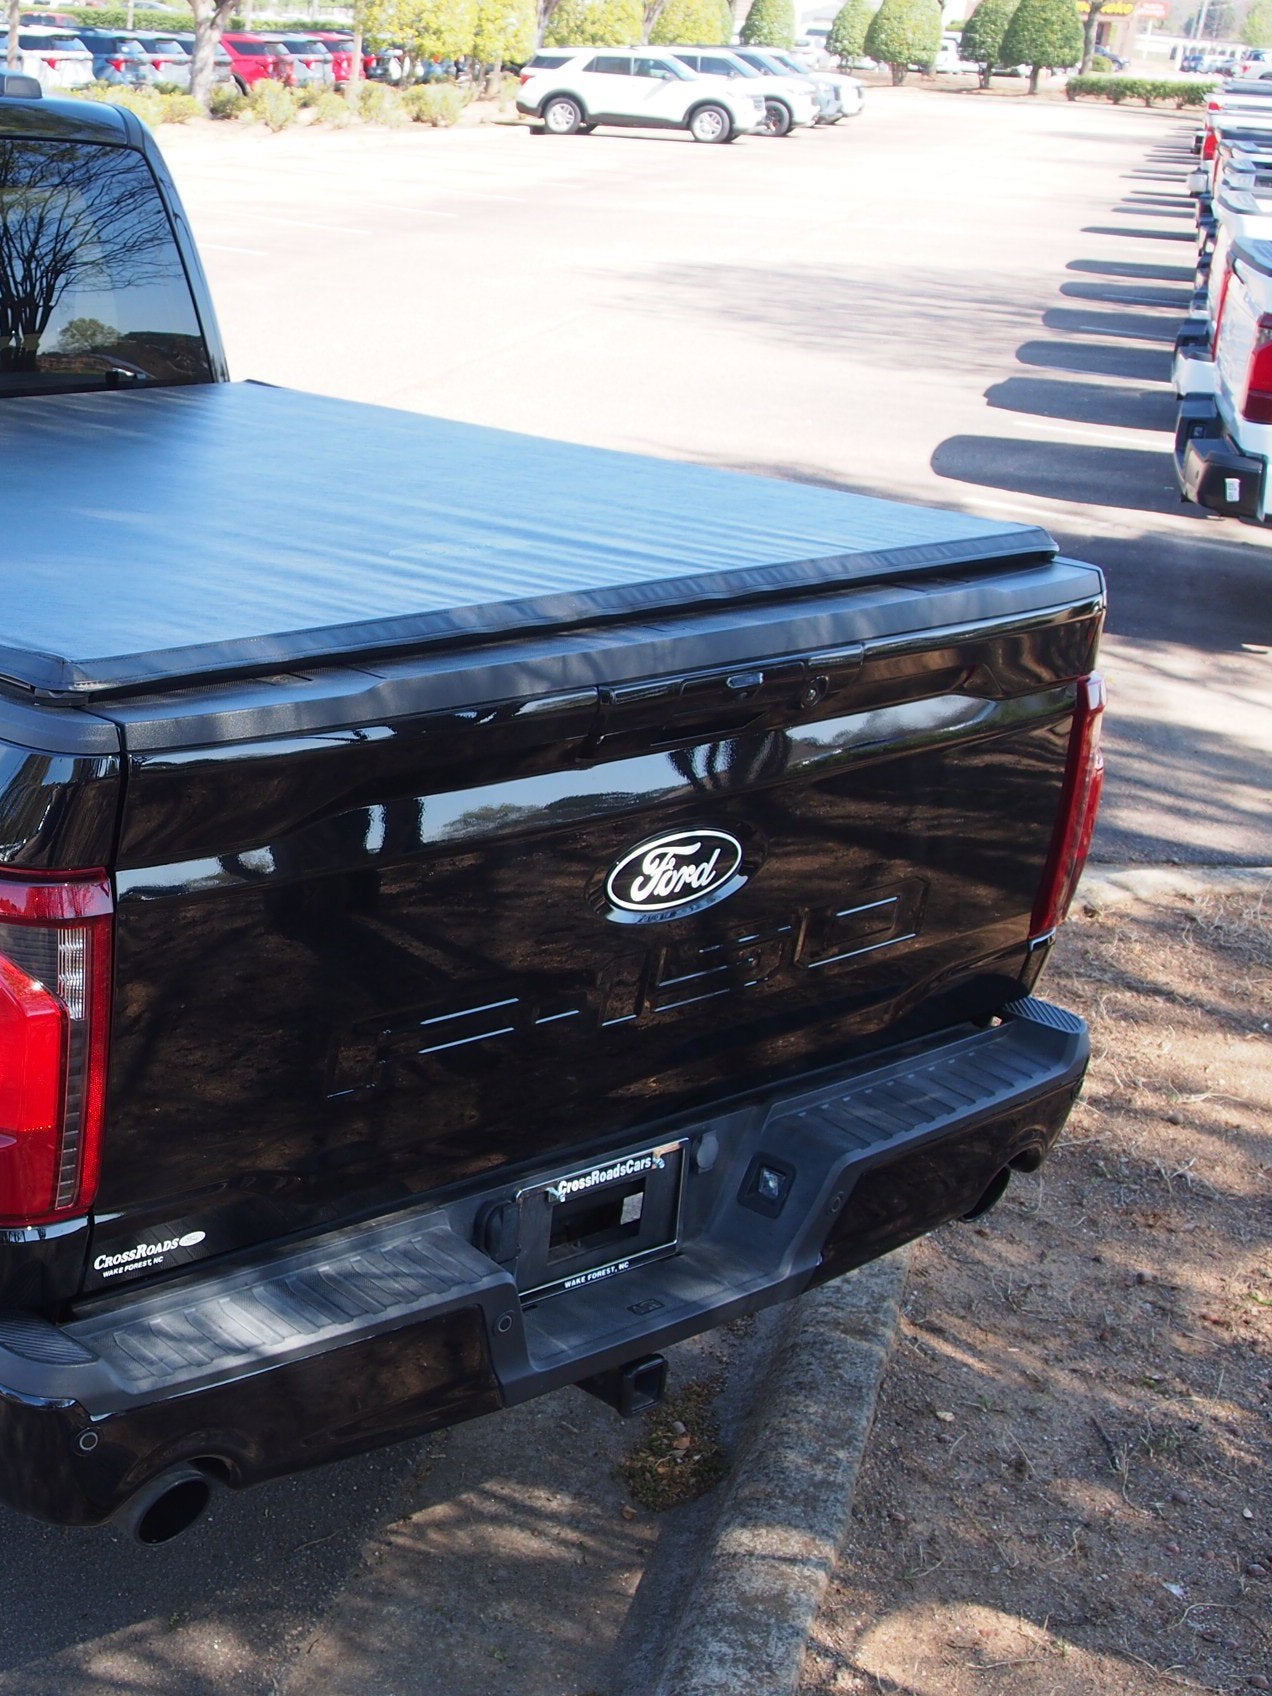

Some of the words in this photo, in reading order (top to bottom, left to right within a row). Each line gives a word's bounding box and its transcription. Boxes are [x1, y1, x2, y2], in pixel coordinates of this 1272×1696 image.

[630, 842, 721, 902] Ford
[558, 1156, 652, 1195] CrossRoadsCars
[103, 1268, 124, 1278] WAKE
[153, 1255, 164, 1264] NC
[564, 1276, 586, 1289] WAKE
[587, 1266, 618, 1281] FOREST,
[618, 1261, 630, 1271] NC
